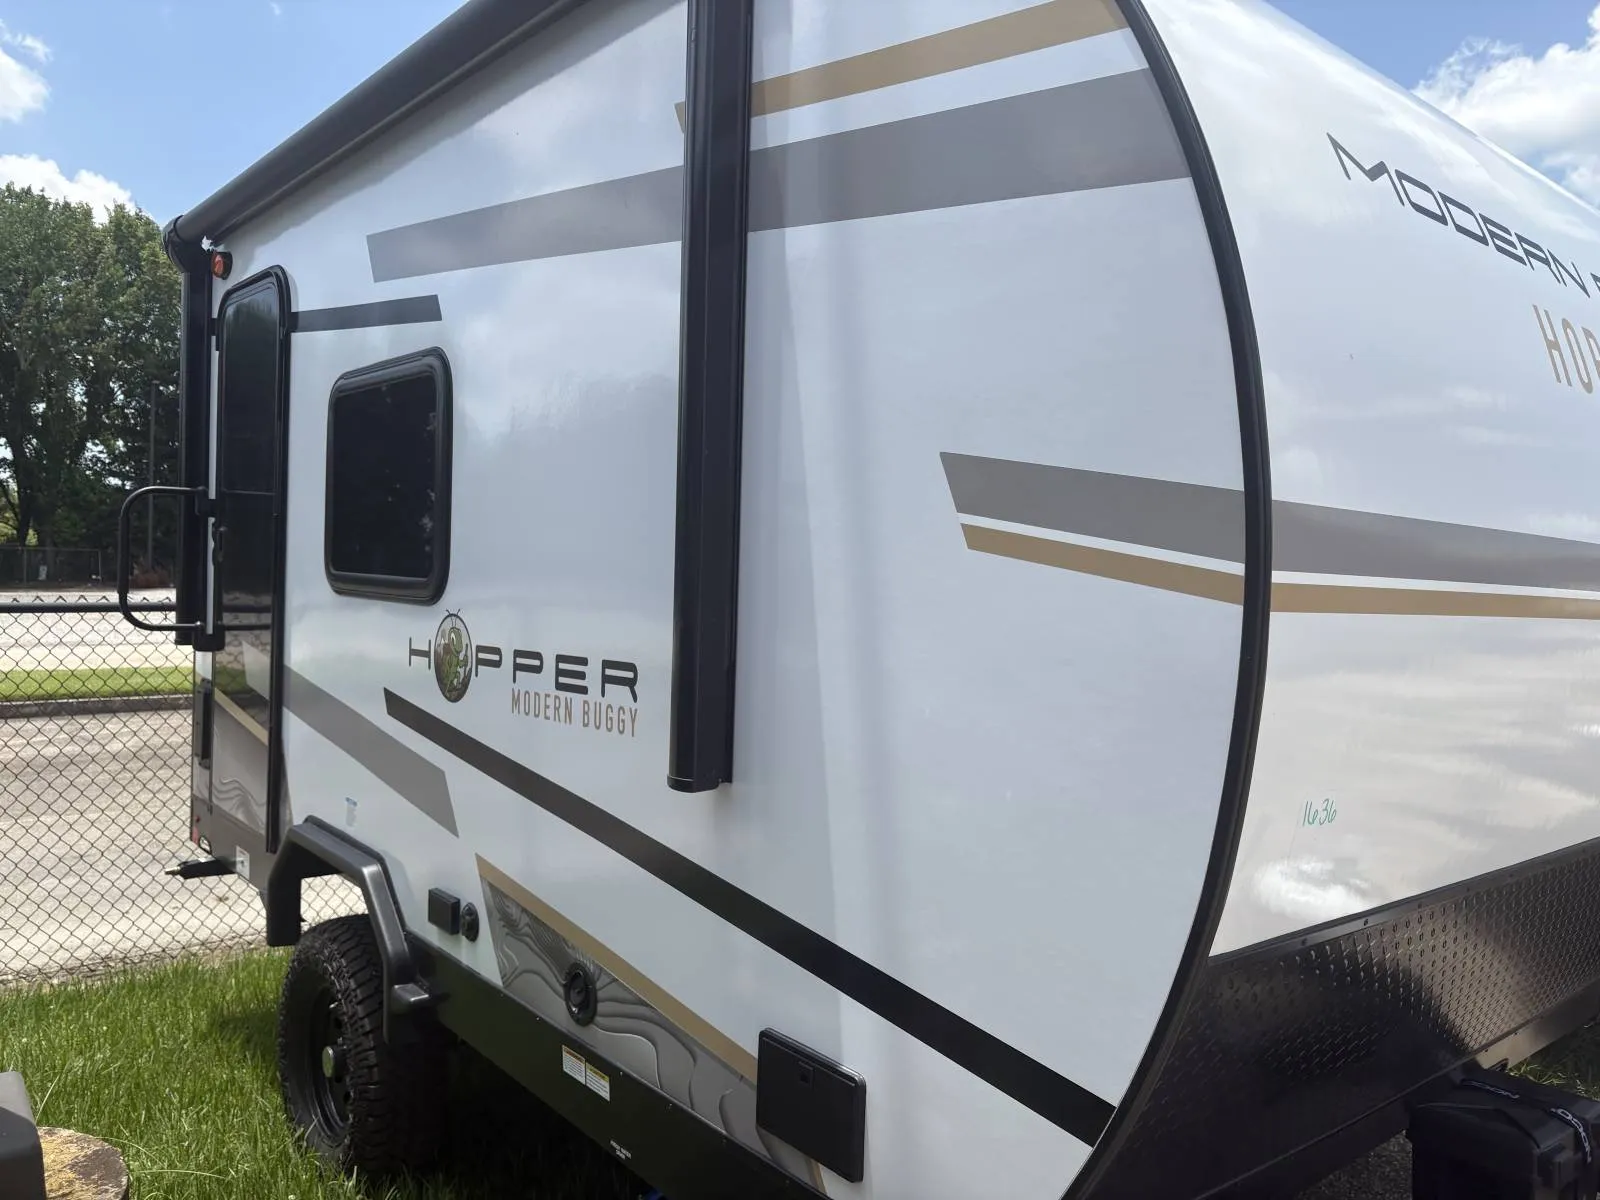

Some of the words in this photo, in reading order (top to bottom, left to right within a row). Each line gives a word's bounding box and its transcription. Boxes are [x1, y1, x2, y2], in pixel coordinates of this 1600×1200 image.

[1326, 132, 1590, 298] MODERN
[511, 687, 573, 725] MODERN
[582, 699, 638, 738] BUGGY
[1302, 798, 1337, 827] 1636
